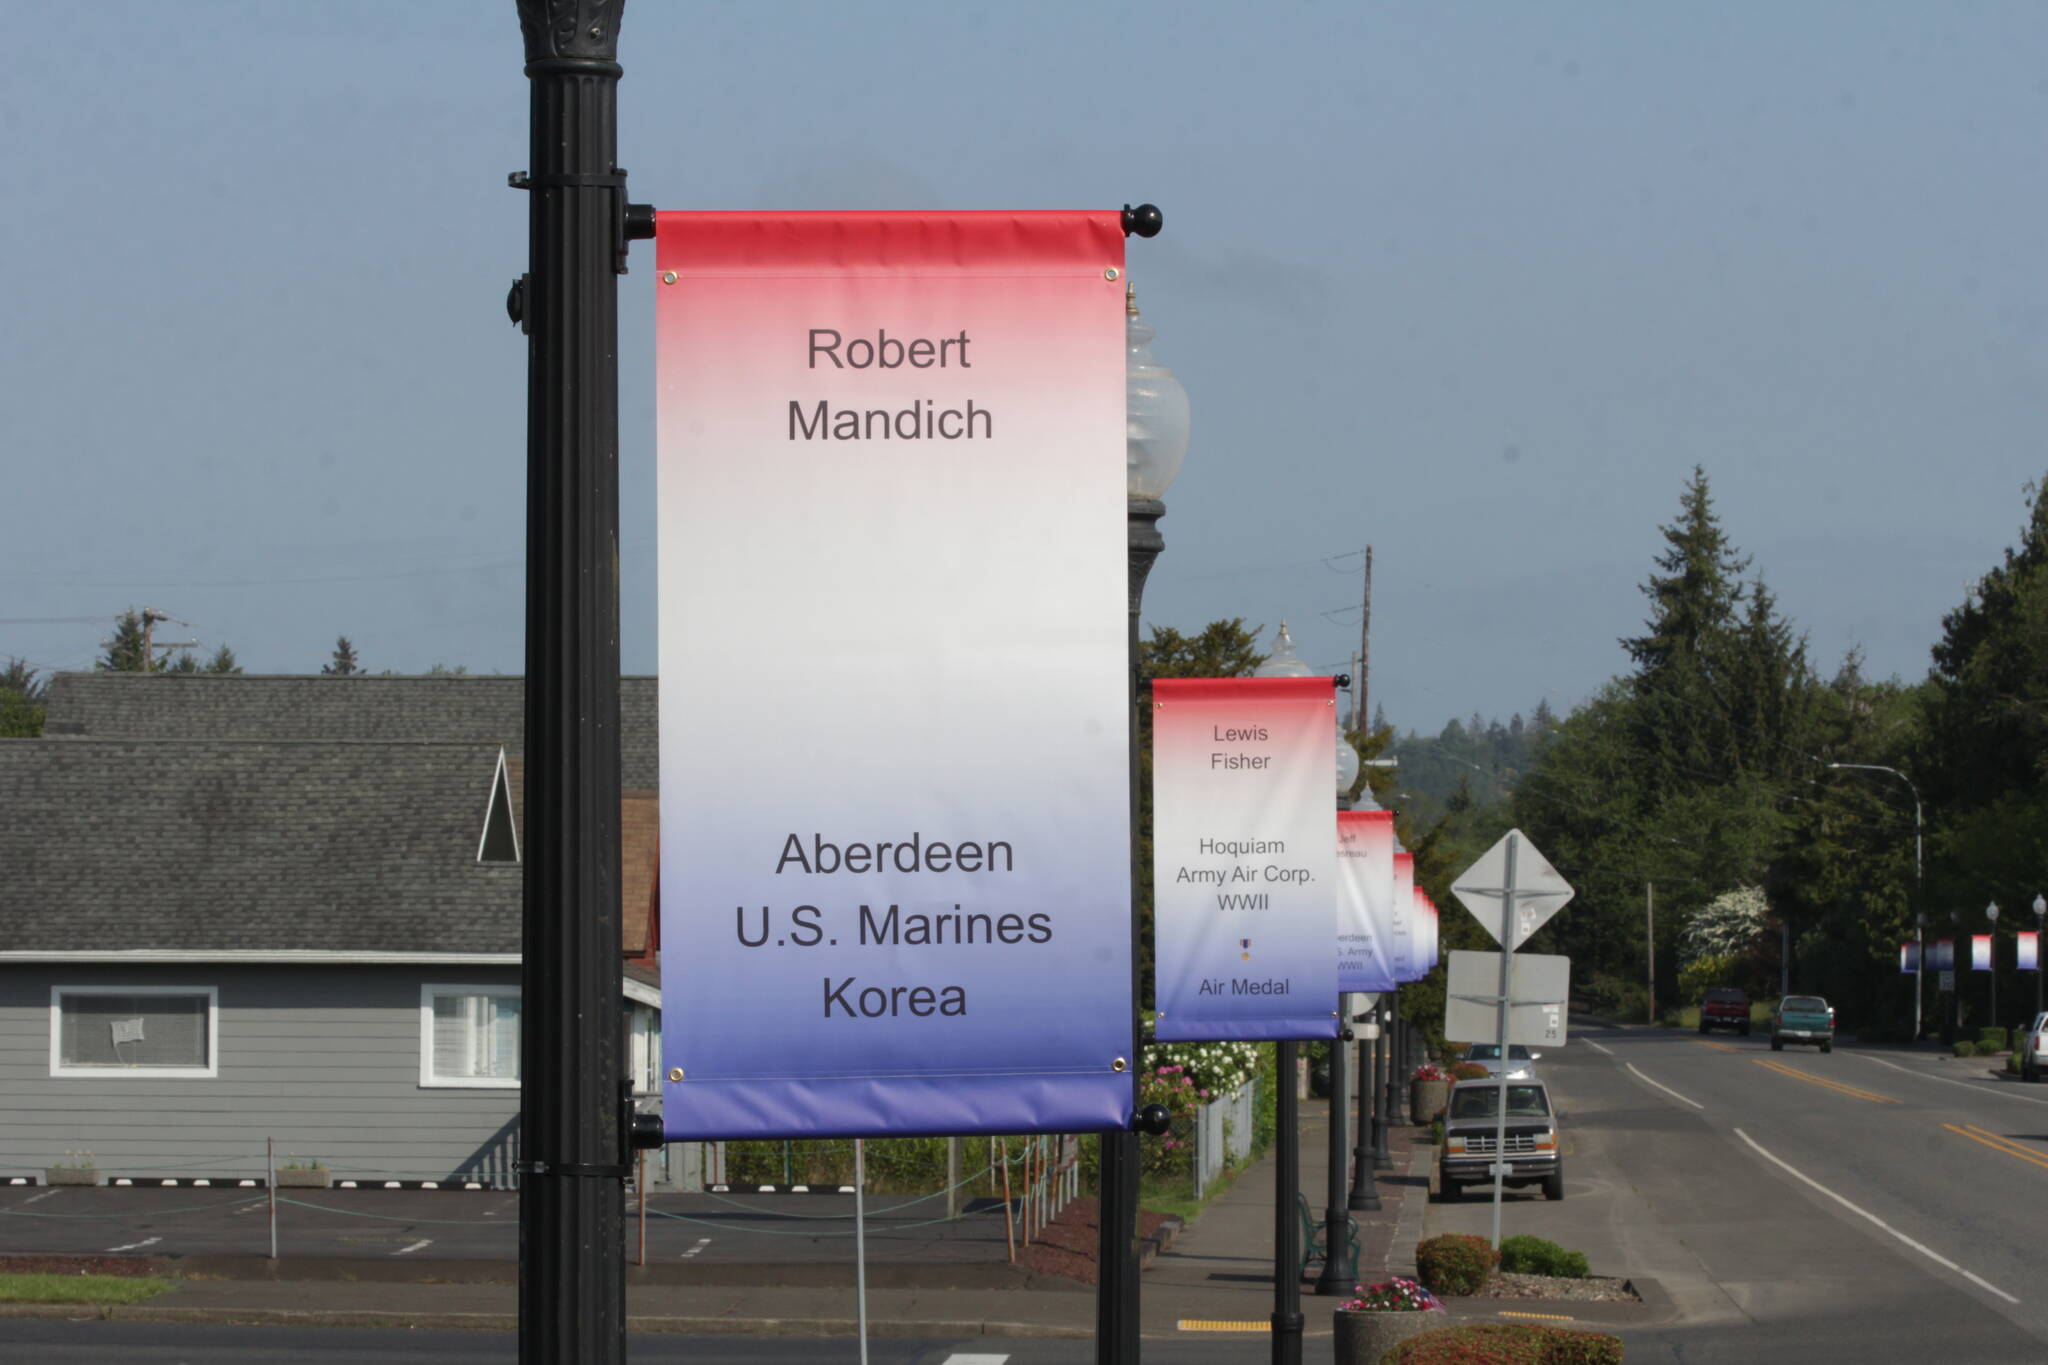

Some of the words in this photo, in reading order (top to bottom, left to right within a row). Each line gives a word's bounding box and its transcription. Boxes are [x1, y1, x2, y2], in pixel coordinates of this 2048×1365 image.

[808, 328, 971, 369] Robert
[789, 399, 992, 441] Mandich
[1214, 724, 1268, 742] Lewis
[1211, 752, 1271, 770] Fisher
[775, 831, 1013, 874] Aberdeen
[1199, 837, 1285, 858] Hoquiam
[1176, 866, 1226, 888] Army
[1231, 865, 1258, 883] Air
[1264, 864, 1316, 886] Corp.
[1217, 893, 1269, 911] WWII
[736, 904, 837, 947] U.S.
[859, 903, 1053, 946] Marines
[1336, 932, 1372, 943] erdeen
[1347, 947, 1373, 959] Army
[823, 977, 967, 1018] Korea
[1198, 978, 1226, 995] Air
[1231, 978, 1290, 996] Medal
